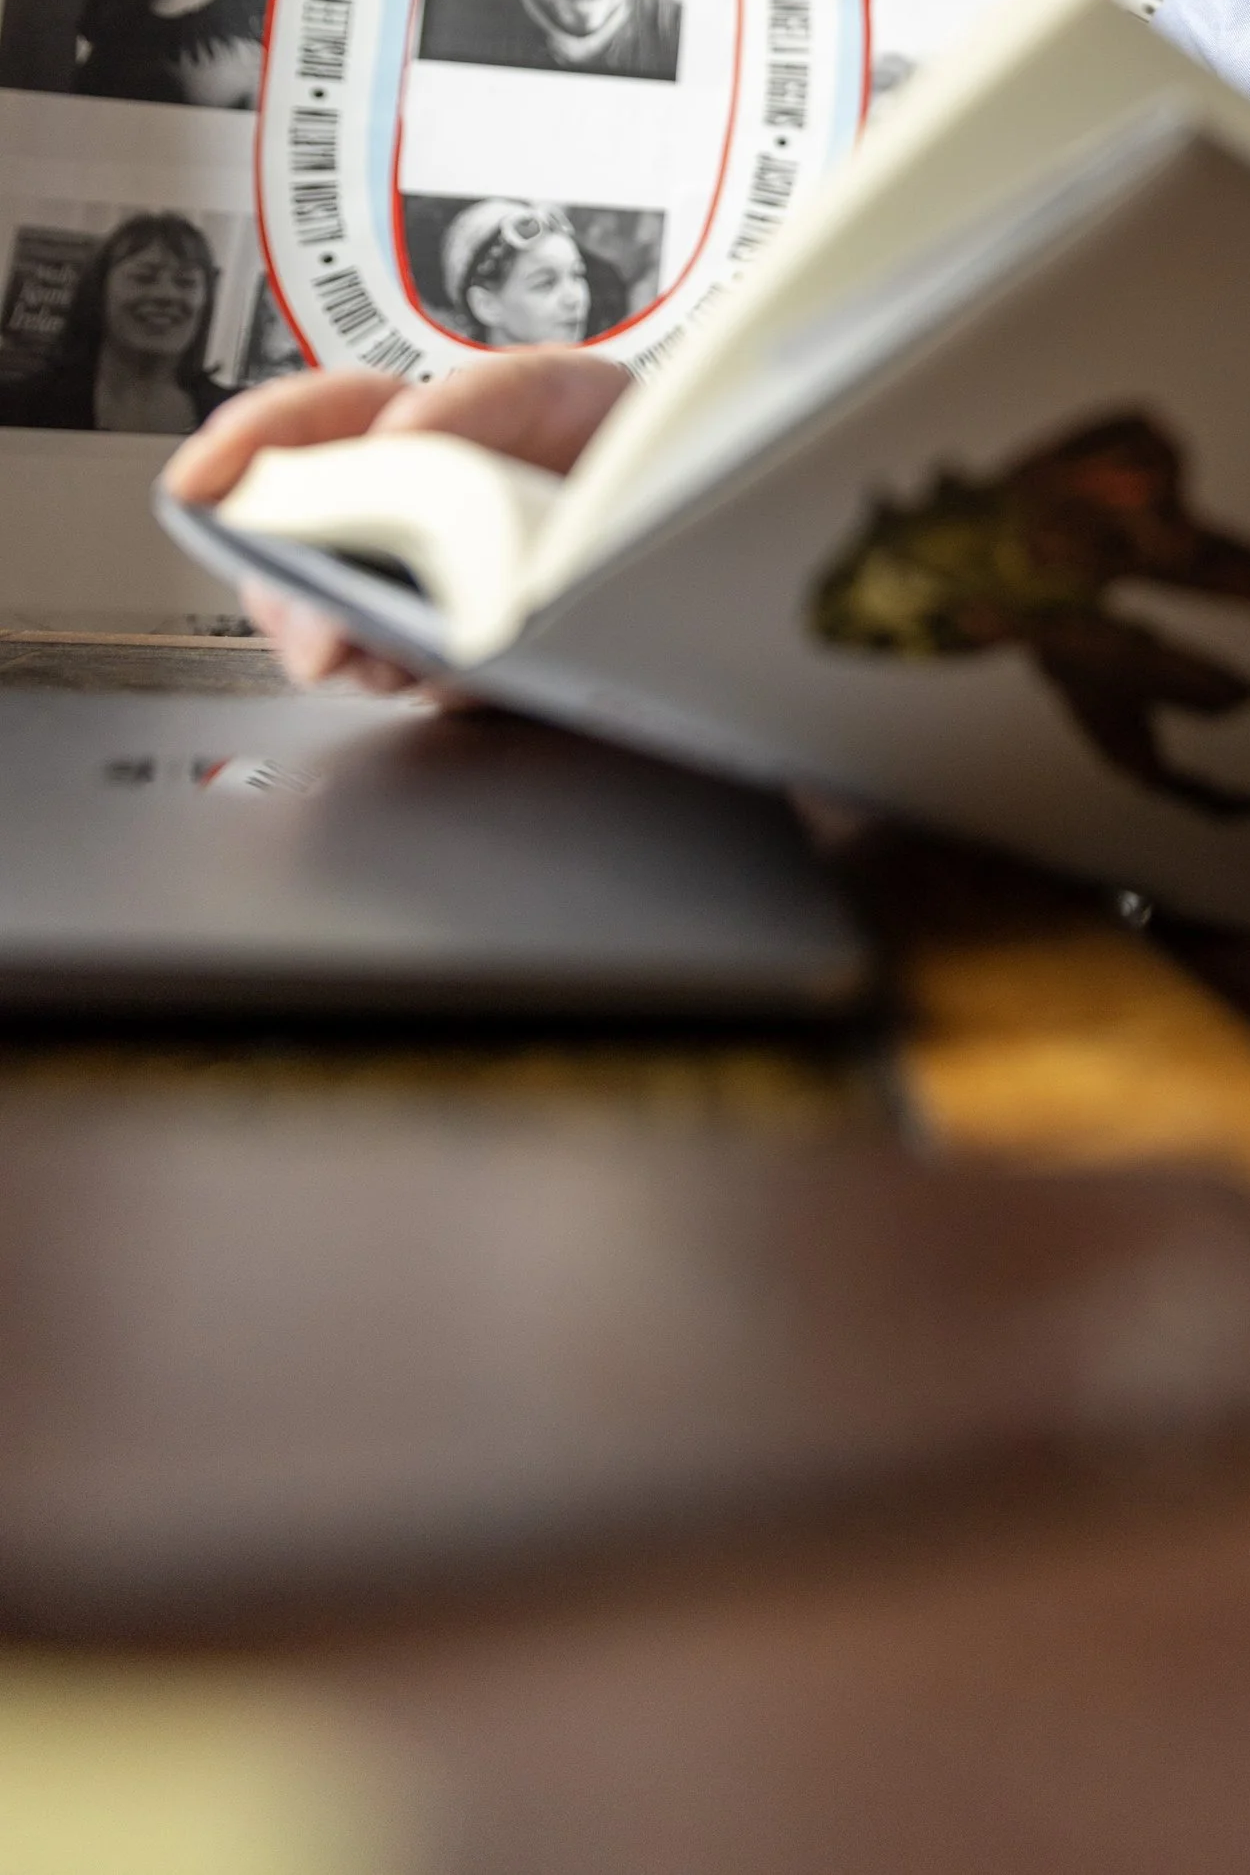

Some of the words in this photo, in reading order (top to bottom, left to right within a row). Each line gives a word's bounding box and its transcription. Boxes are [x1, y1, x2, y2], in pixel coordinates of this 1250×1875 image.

[763, 62, 810, 130] HIGGINS
[288, 106, 338, 175] MARTIN
[290, 180, 345, 246] ALISON
[748, 151, 800, 210] JASON
[311, 266, 387, 346] LORDAN
[358, 327, 424, 378] DAVE
